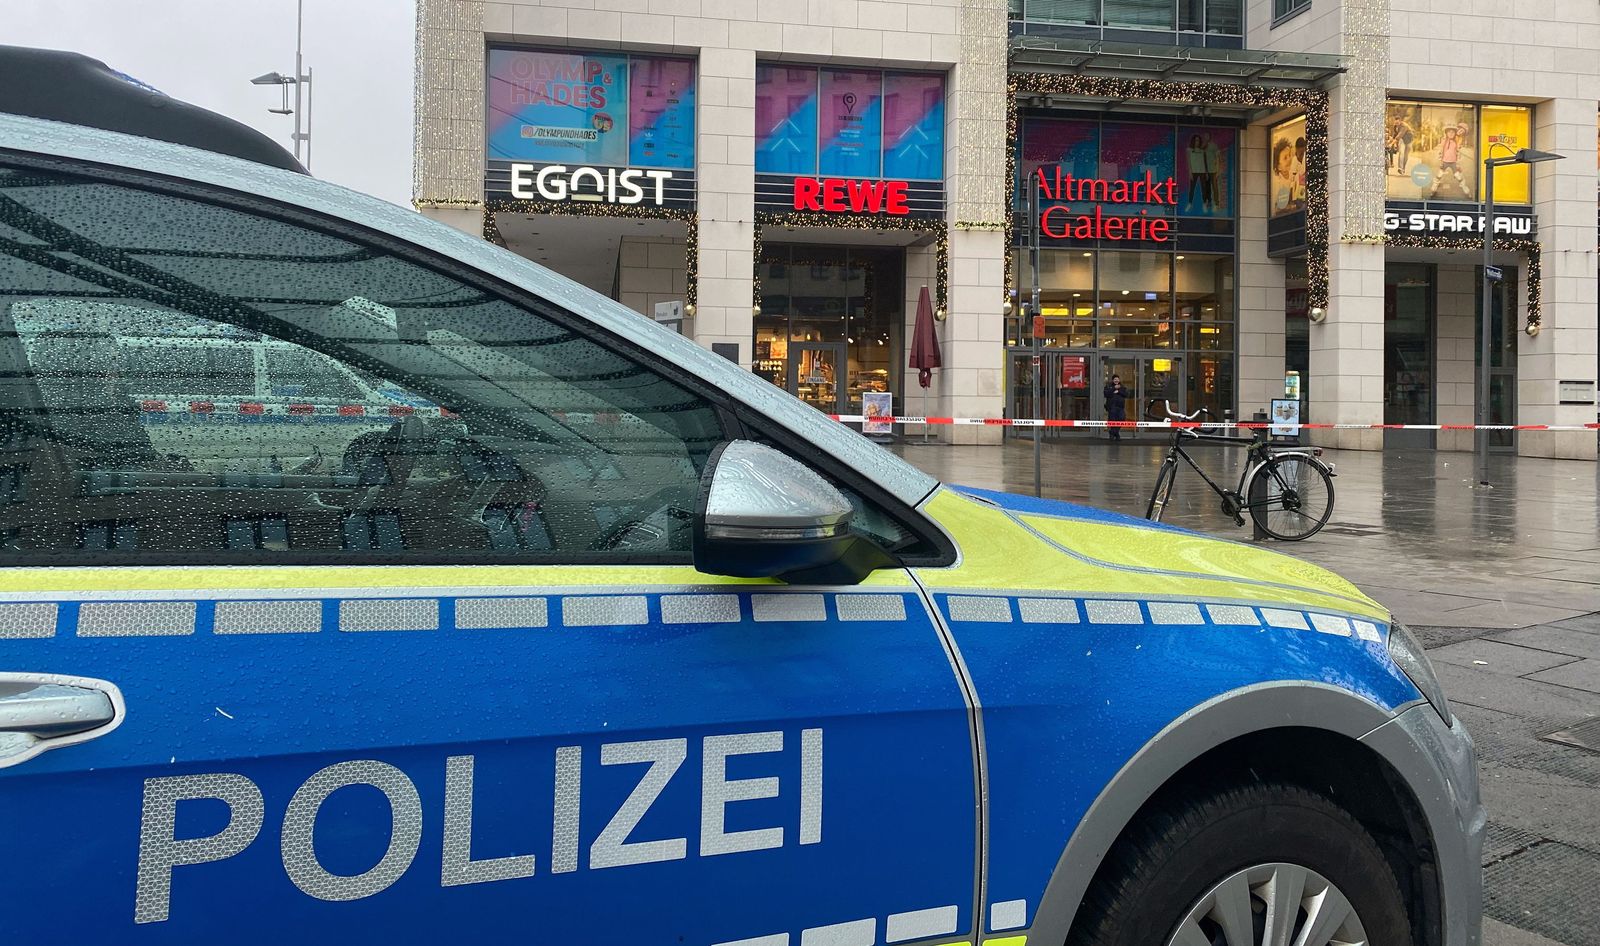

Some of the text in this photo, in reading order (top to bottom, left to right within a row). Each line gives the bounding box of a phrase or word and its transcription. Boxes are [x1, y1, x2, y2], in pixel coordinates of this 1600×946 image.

[510, 56, 613, 85] OLYMP &
[510, 80, 608, 109] HADES
[511, 163, 673, 206] EGOIST
[793, 176, 911, 215] REWE
[1036, 165, 1177, 204] Altmarkt
[1040, 204, 1170, 242] Galerie
[1384, 211, 1473, 232] G-STAR
[134, 727, 824, 925] POLIZEI
